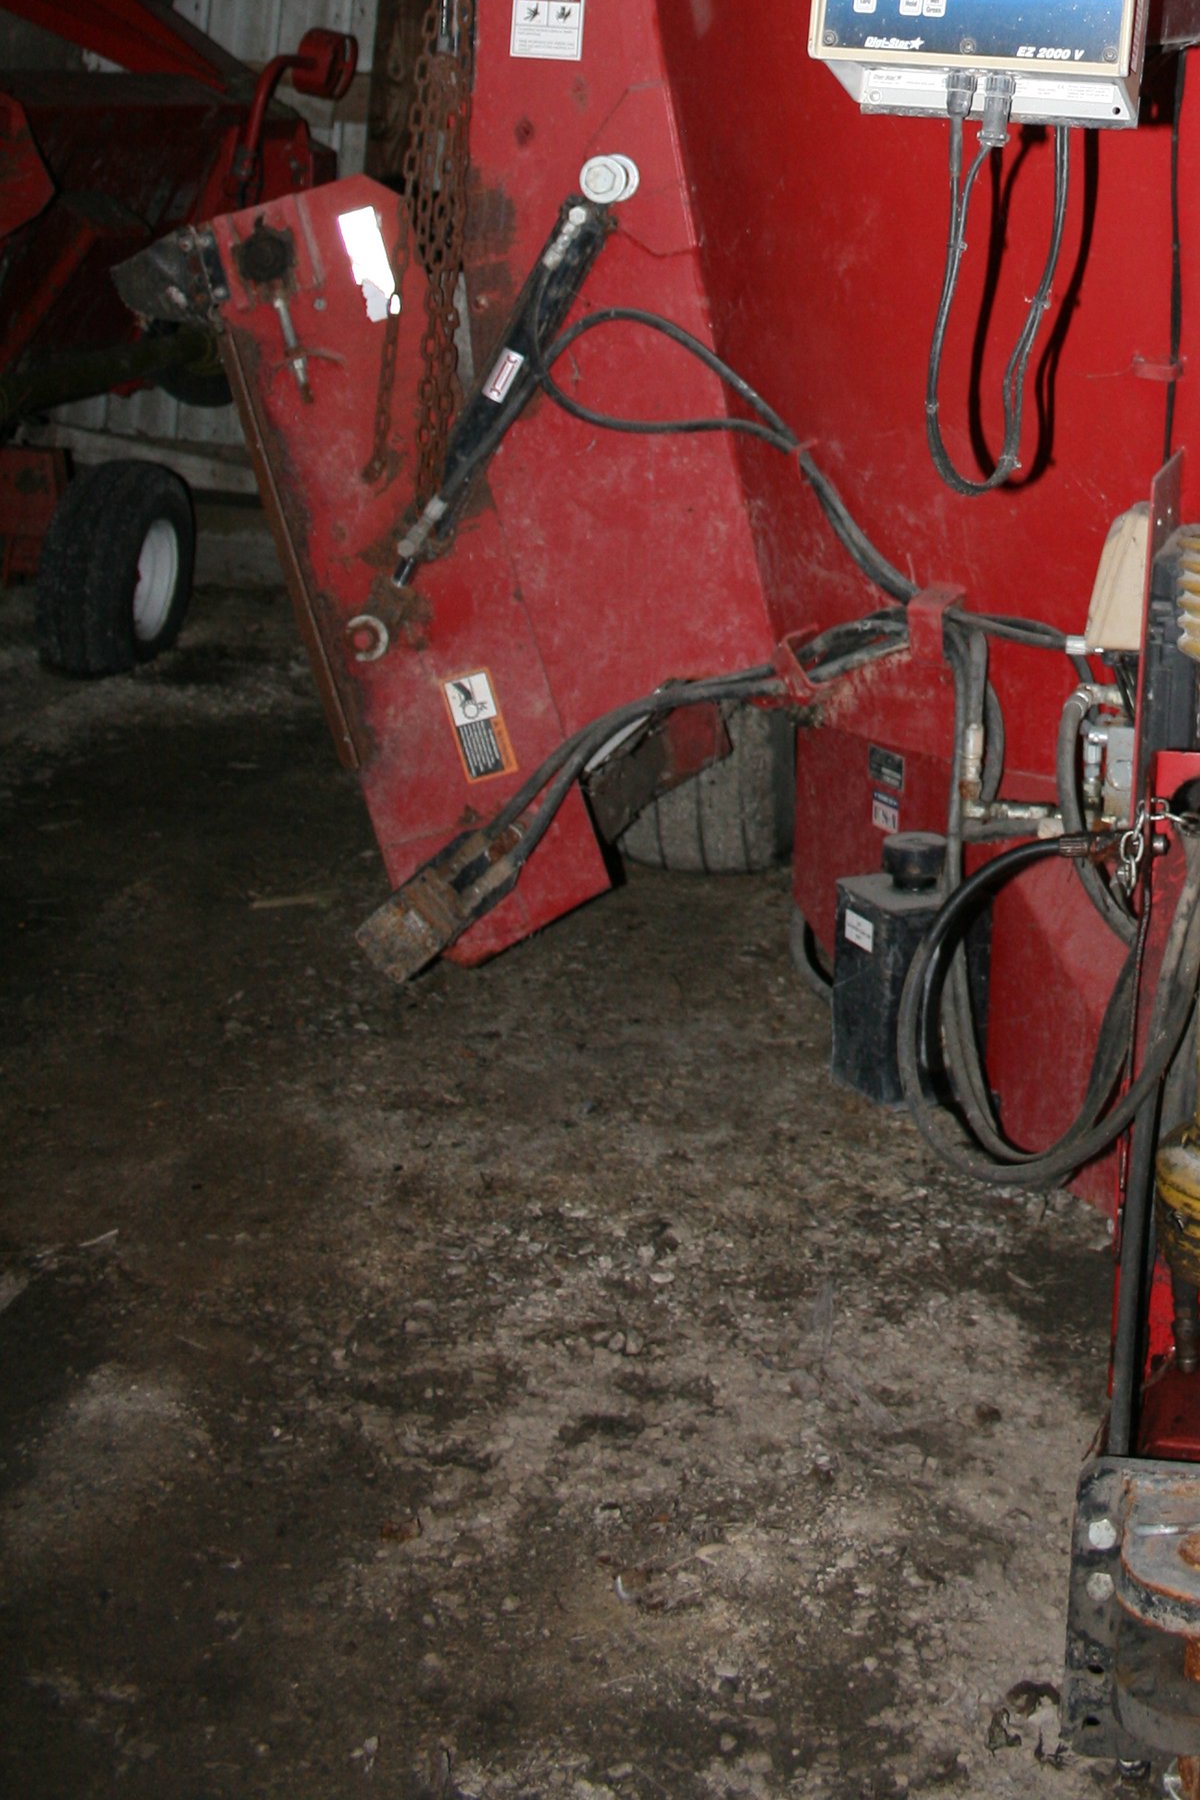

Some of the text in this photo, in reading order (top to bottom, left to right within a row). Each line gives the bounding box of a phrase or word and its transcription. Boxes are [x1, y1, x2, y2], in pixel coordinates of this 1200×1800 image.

[1016, 46, 1085, 60] EZ 2000 V
